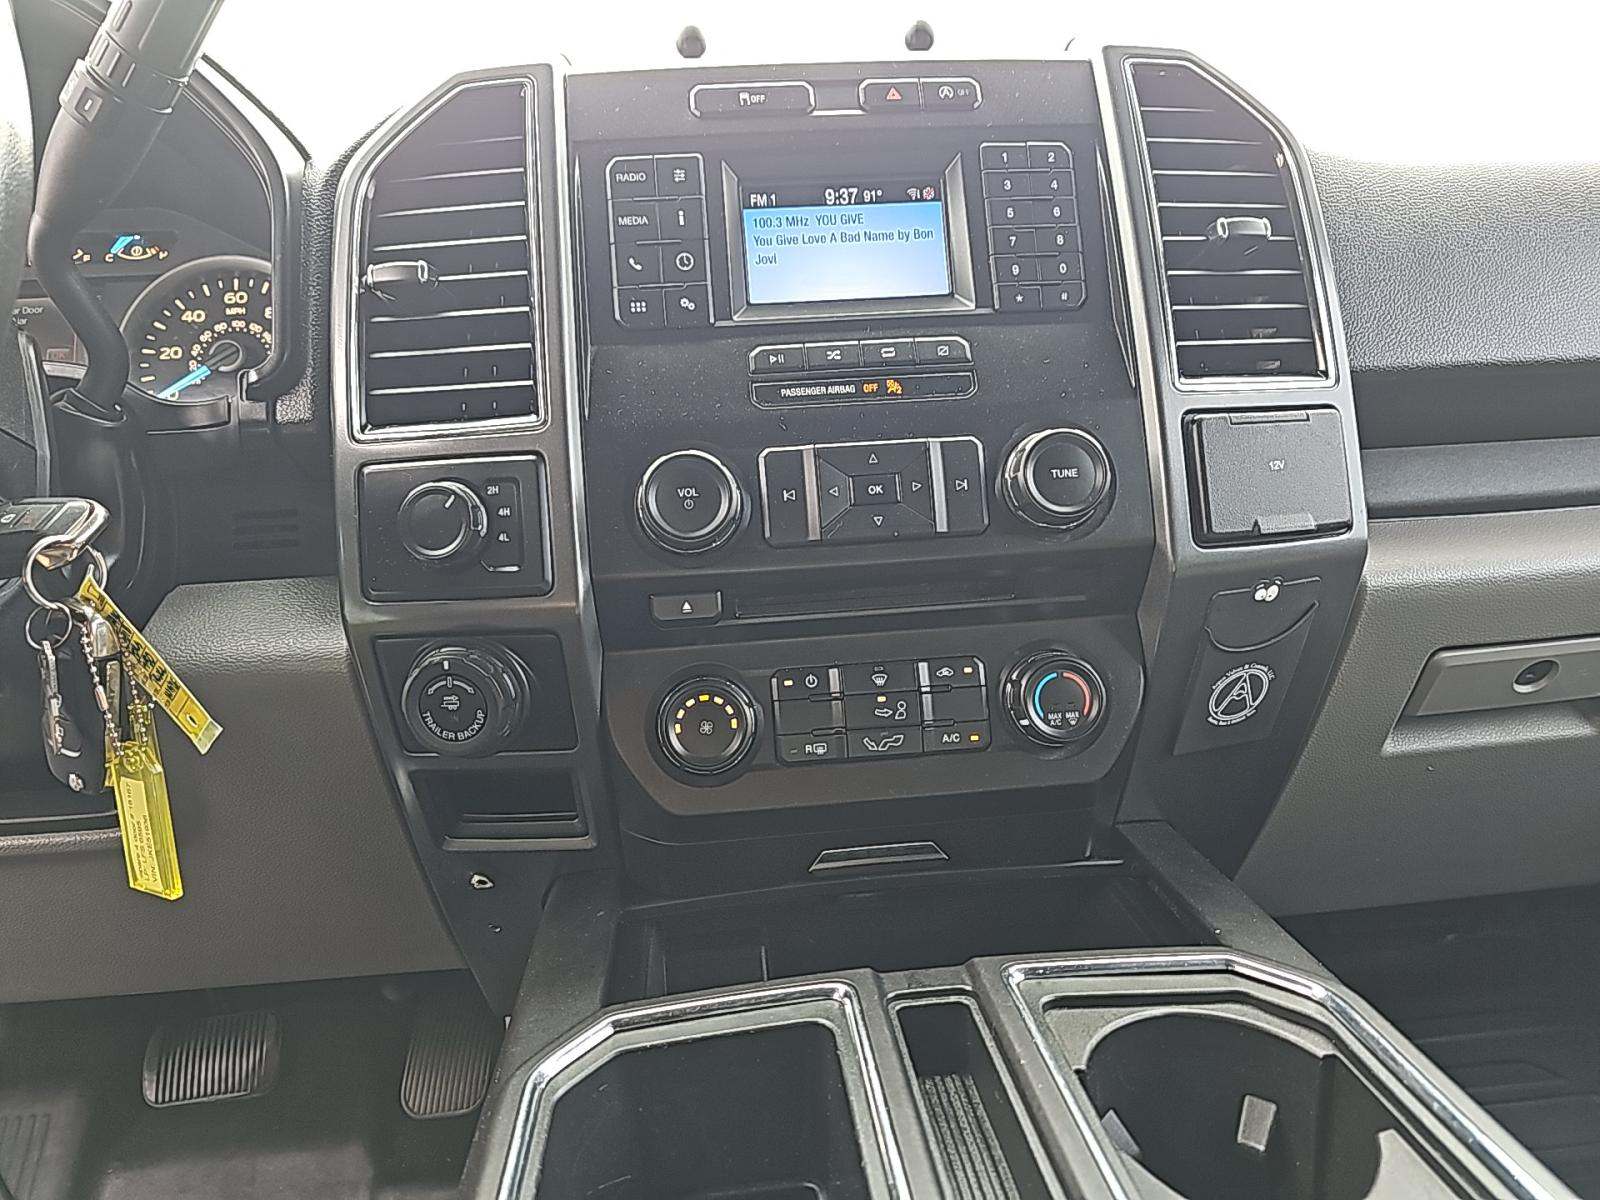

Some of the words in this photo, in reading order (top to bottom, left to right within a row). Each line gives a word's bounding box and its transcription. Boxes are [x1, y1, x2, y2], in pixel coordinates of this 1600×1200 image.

[750, 94, 766, 103] OFF
[1002, 153, 1008, 163] 1
[1048, 152, 1055, 162] 2
[616, 172, 646, 182] RADIO
[1004, 180, 1011, 190] 3
[1050, 180, 1058, 190] 4
[750, 193, 767, 207] FM
[770, 193, 776, 206] 1
[825, 187, 858, 204] 9:37
[1007, 208, 1014, 218] 5
[1053, 207, 1061, 217] 6
[618, 215, 648, 226] MEDIA
[753, 216, 782, 228] 100.3
[785, 215, 809, 227] MHz
[815, 213, 837, 226] YOU
[840, 212, 864, 225] GIVE
[753, 234, 773, 247] You
[776, 234, 799, 246] Give
[802, 232, 826, 245] Love
[829, 232, 837, 243] A
[840, 230, 861, 243] Bad
[863, 230, 895, 242] Name
[897, 229, 910, 243] by
[913, 228, 934, 240] Bon
[1009, 236, 1017, 247] 7
[1056, 235, 1064, 245] 8
[755, 252, 777, 265] Jovi
[1012, 264, 1019, 275] 9
[1060, 263, 1067, 273] 0
[223, 291, 248, 304] 60
[22, 306, 44, 315] Door
[225, 307, 246, 315] MPH
[181, 310, 206, 323] 40
[159, 347, 182, 360] 20
[781, 386, 826, 397] PASSENGER
[827, 384, 855, 394] AIRBAG
[863, 383, 878, 393] OFF
[1268, 460, 1285, 471] 12V
[1051, 468, 1079, 479] TUNE
[487, 486, 499, 495] 2H
[677, 487, 699, 497] VOL
[868, 484, 883, 495] OK
[498, 507, 510, 517] 4H
[498, 533, 509, 542] 4L
[1066, 711, 1079, 719] MAX
[421, 710, 456, 741] TRAILER
[457, 709, 486, 741] BACKUP
[942, 733, 961, 744] A/C
